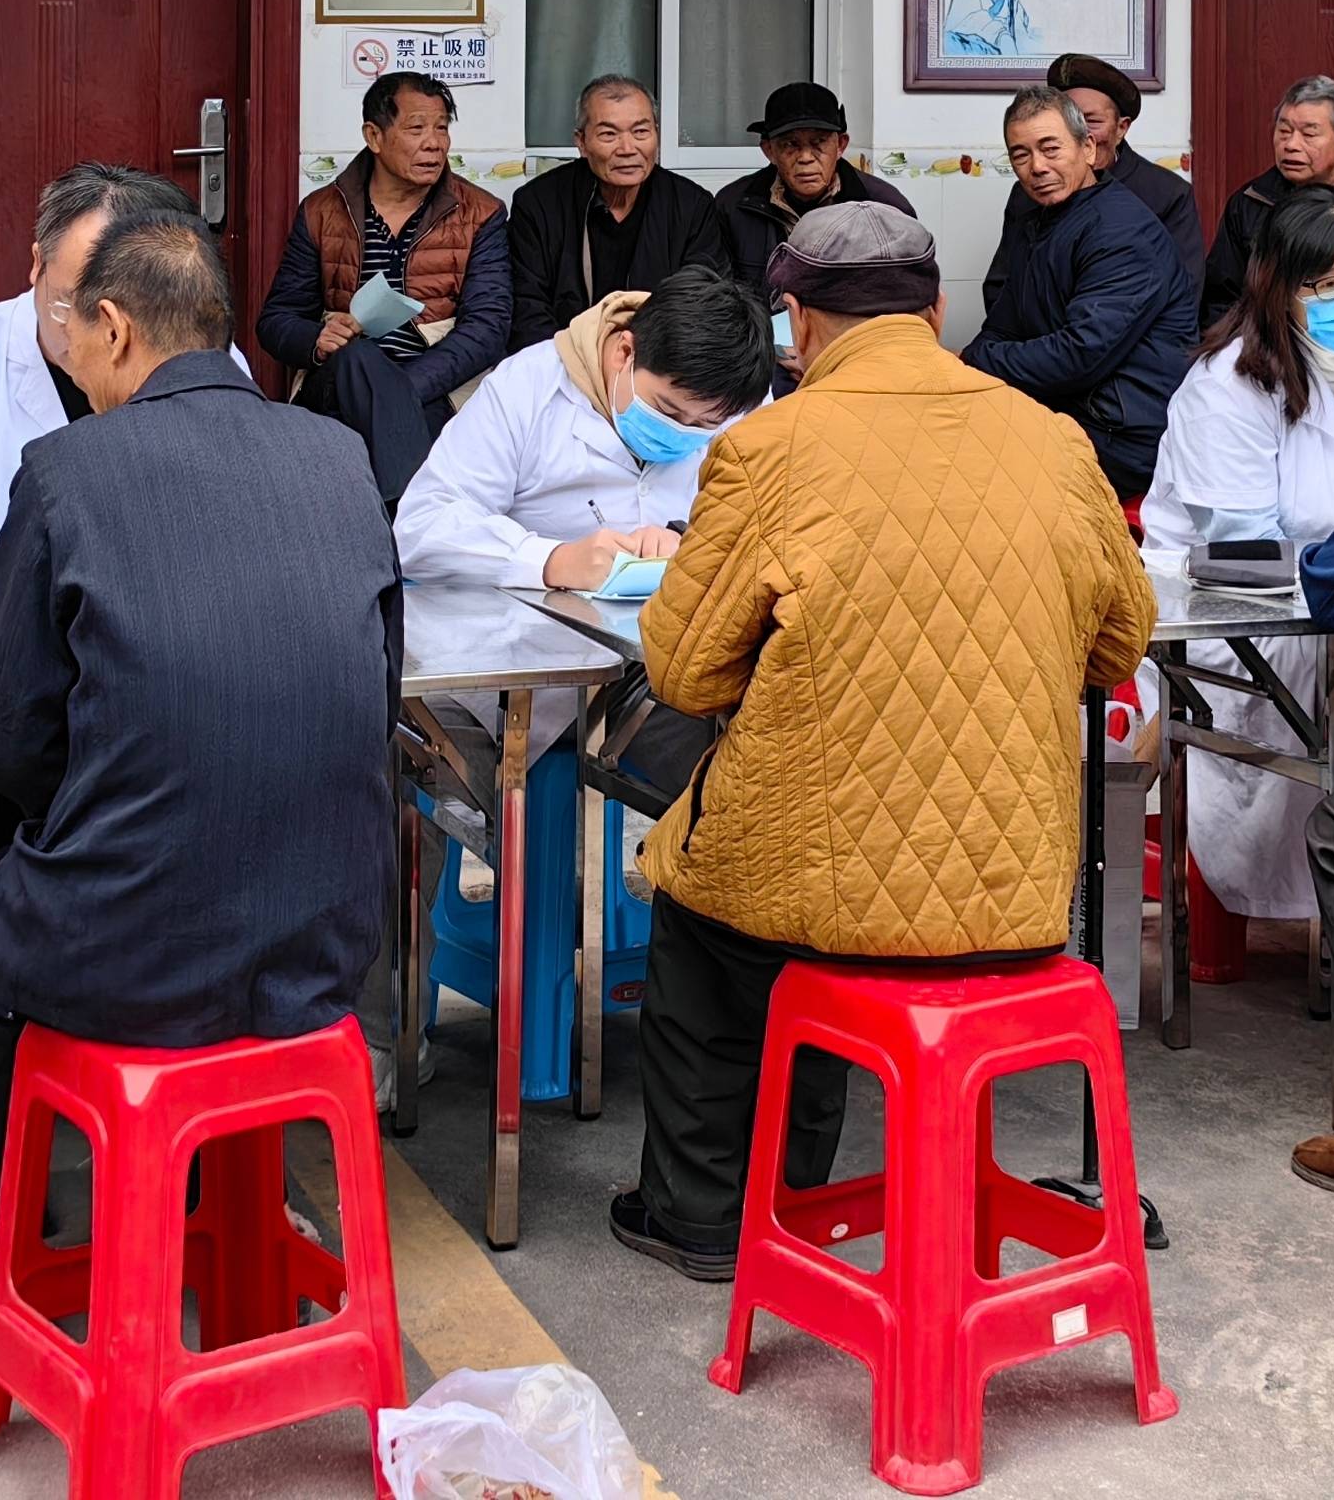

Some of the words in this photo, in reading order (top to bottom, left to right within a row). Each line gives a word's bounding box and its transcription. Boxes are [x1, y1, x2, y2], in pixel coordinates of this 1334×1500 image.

[396, 38, 486, 57] 禁止吸烟
[397, 60, 415, 68] NO
[422, 60, 486, 68] SMOKING
